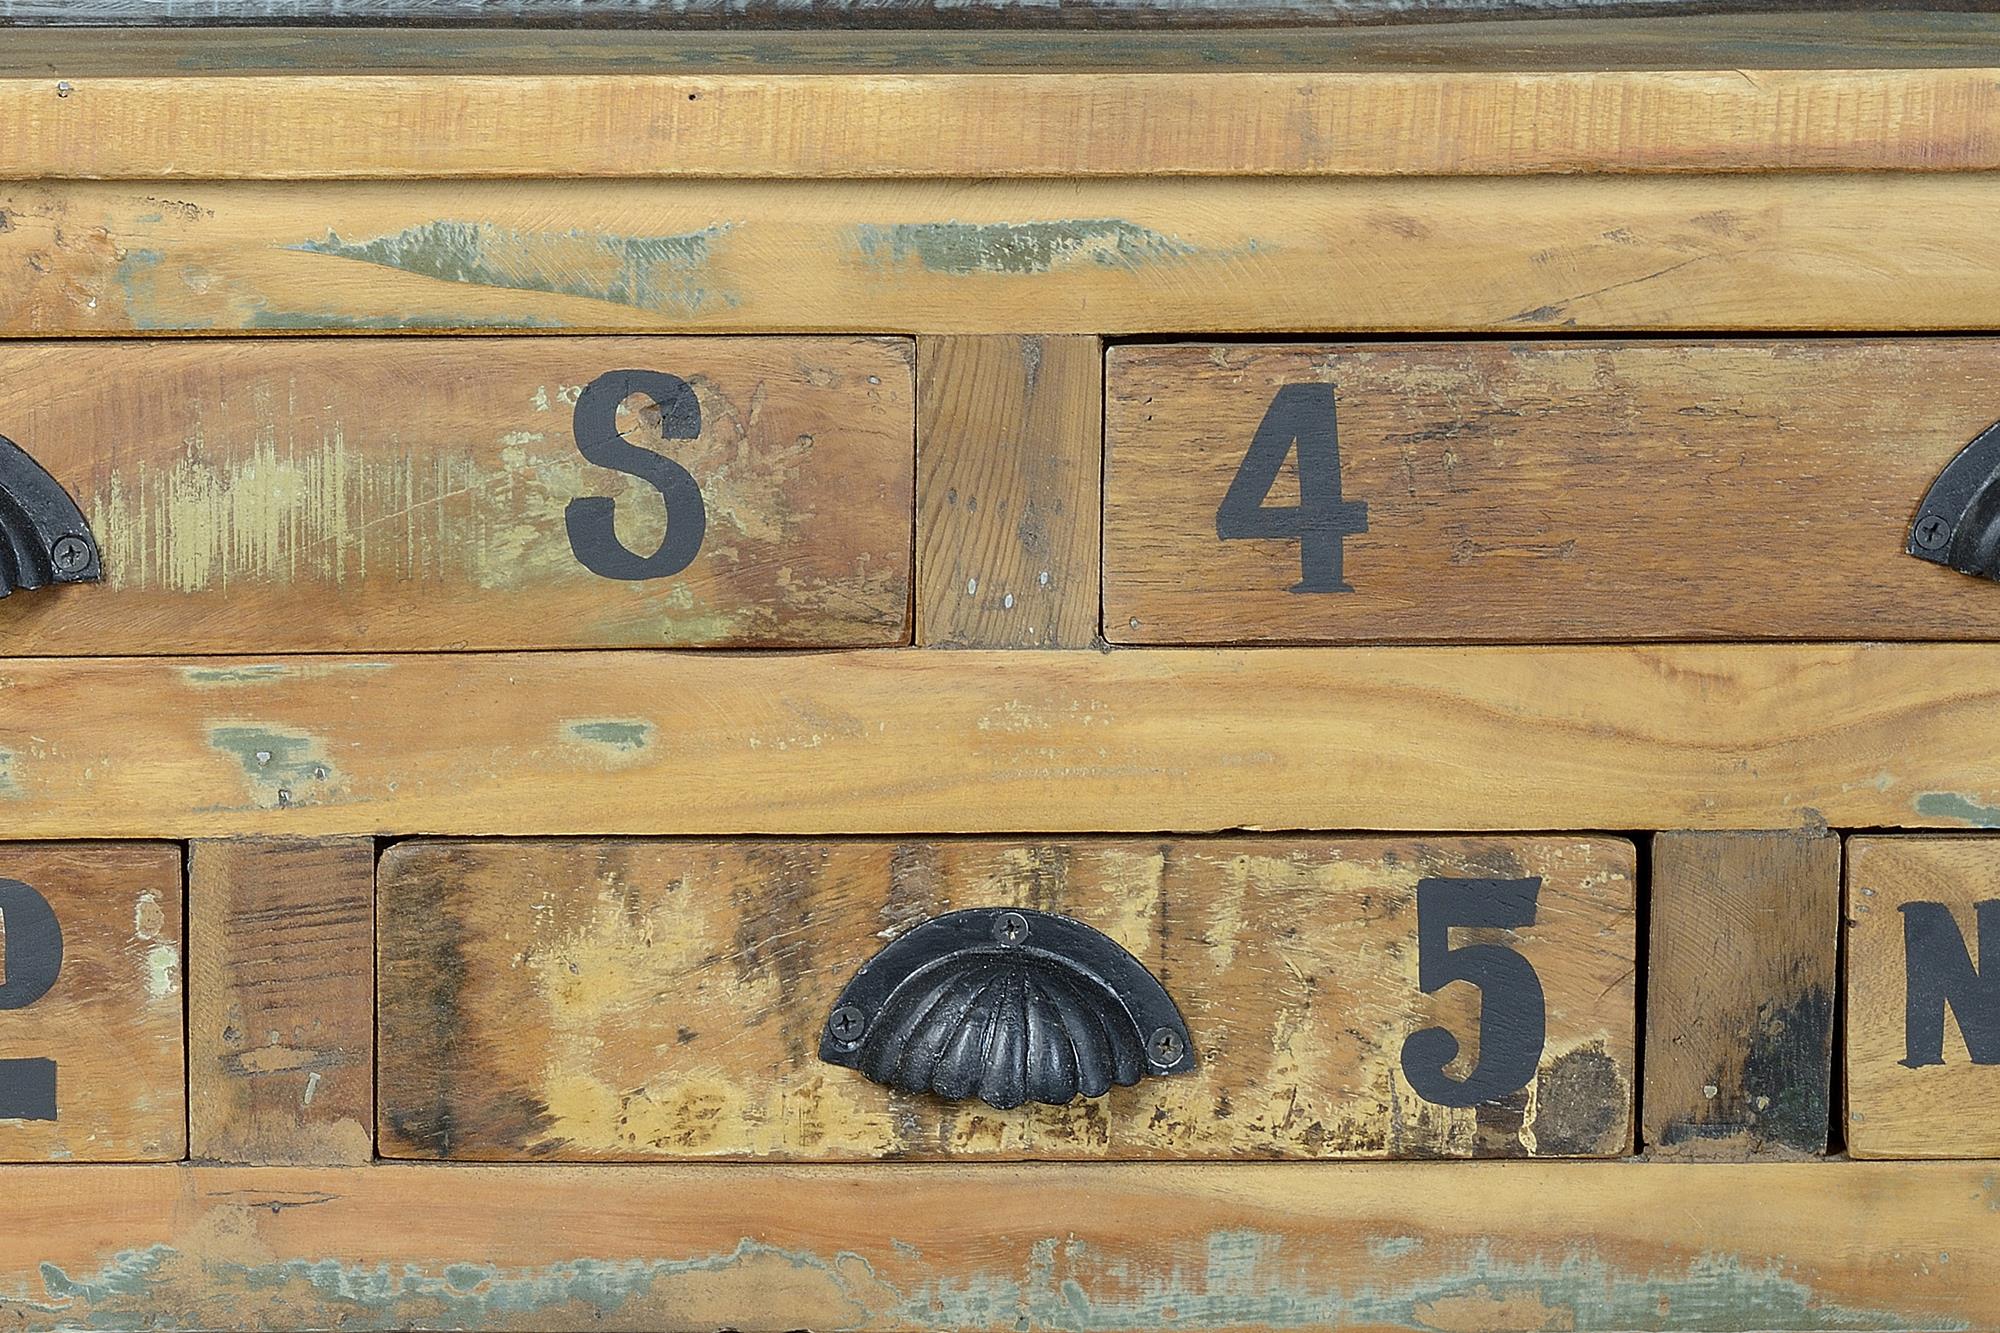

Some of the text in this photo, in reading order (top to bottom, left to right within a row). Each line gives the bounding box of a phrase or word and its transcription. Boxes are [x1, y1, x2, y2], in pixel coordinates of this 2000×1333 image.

[567, 370, 704, 580] S
[1217, 383, 1368, 593] 4
[1402, 878, 1544, 1107] 5
[1898, 899, 2000, 1068] N
